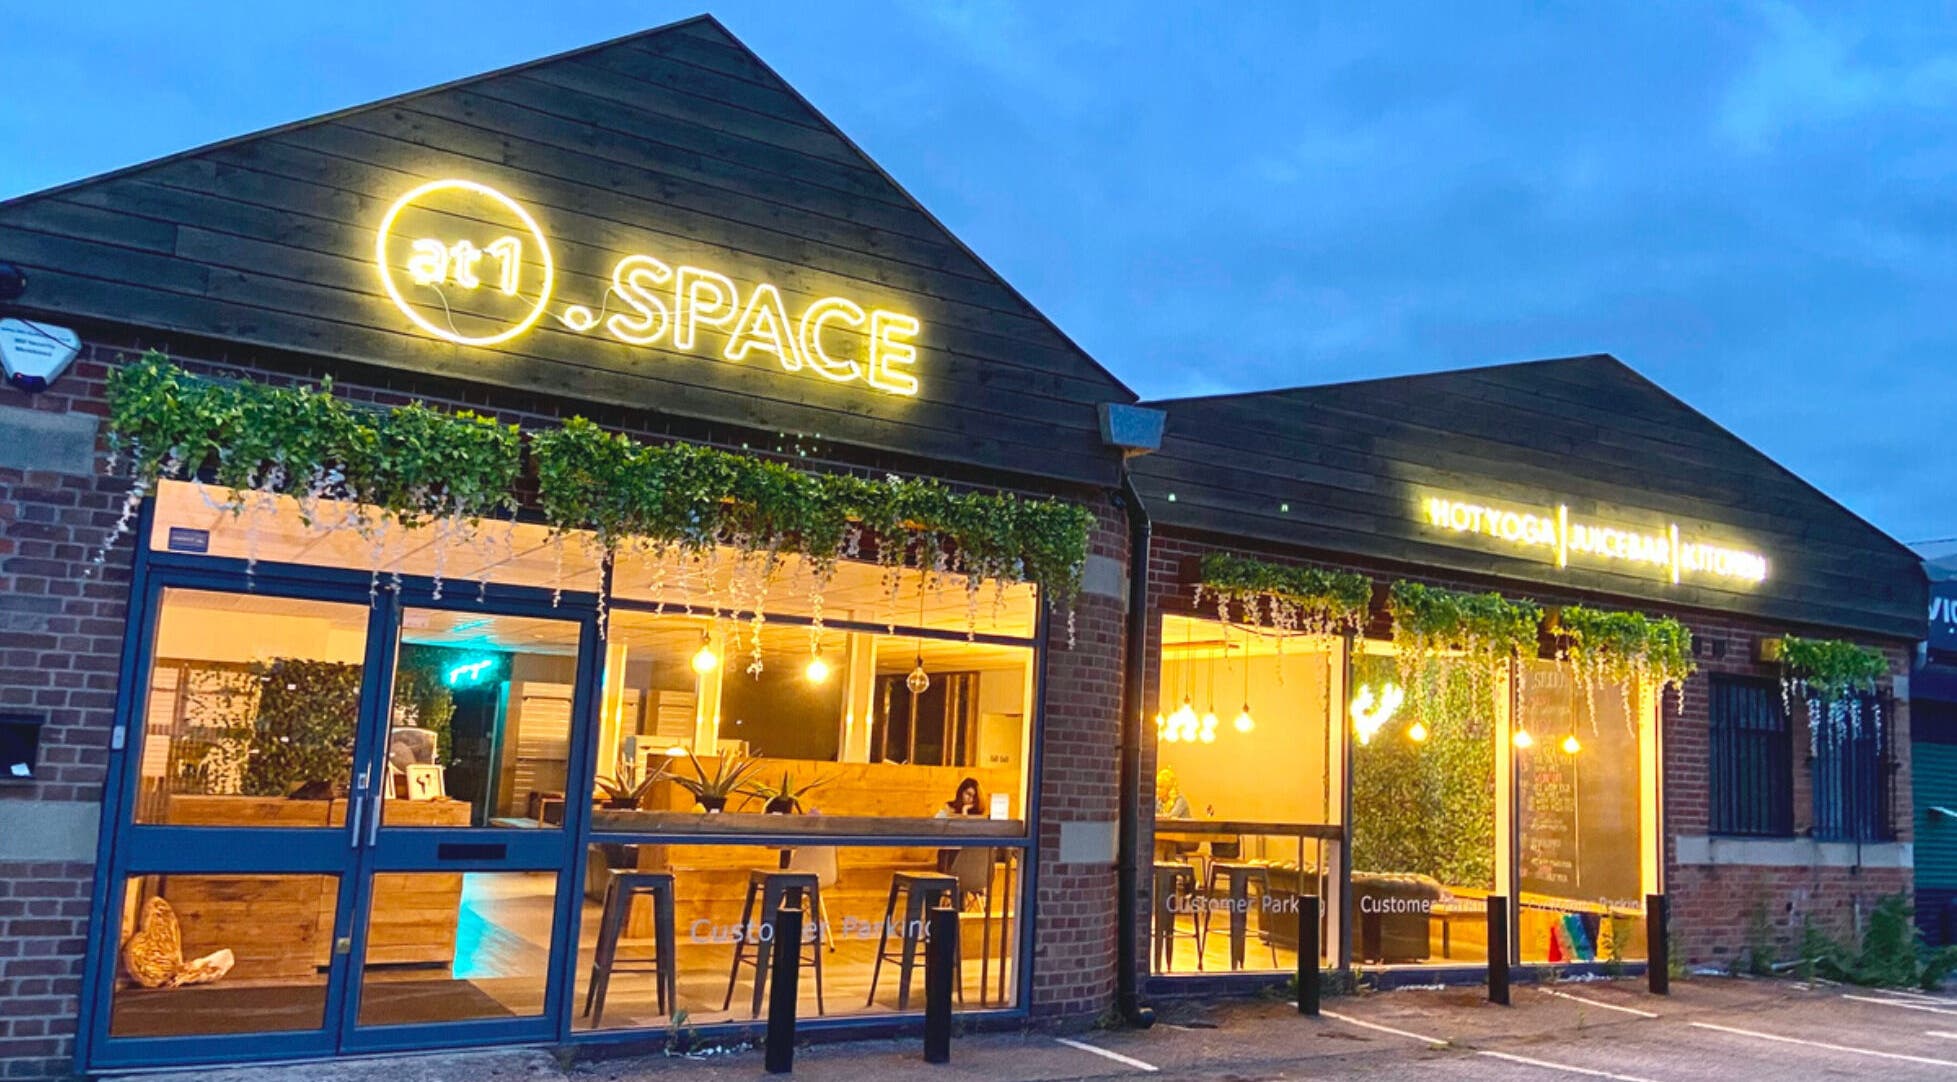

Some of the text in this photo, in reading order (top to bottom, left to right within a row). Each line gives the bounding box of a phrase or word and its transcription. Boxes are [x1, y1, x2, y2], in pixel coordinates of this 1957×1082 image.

[407, 235, 523, 296] at1
[1681, 543, 1767, 582] KITC
[1262, 894, 1326, 919] Parkg
[690, 918, 827, 944] Custoer
